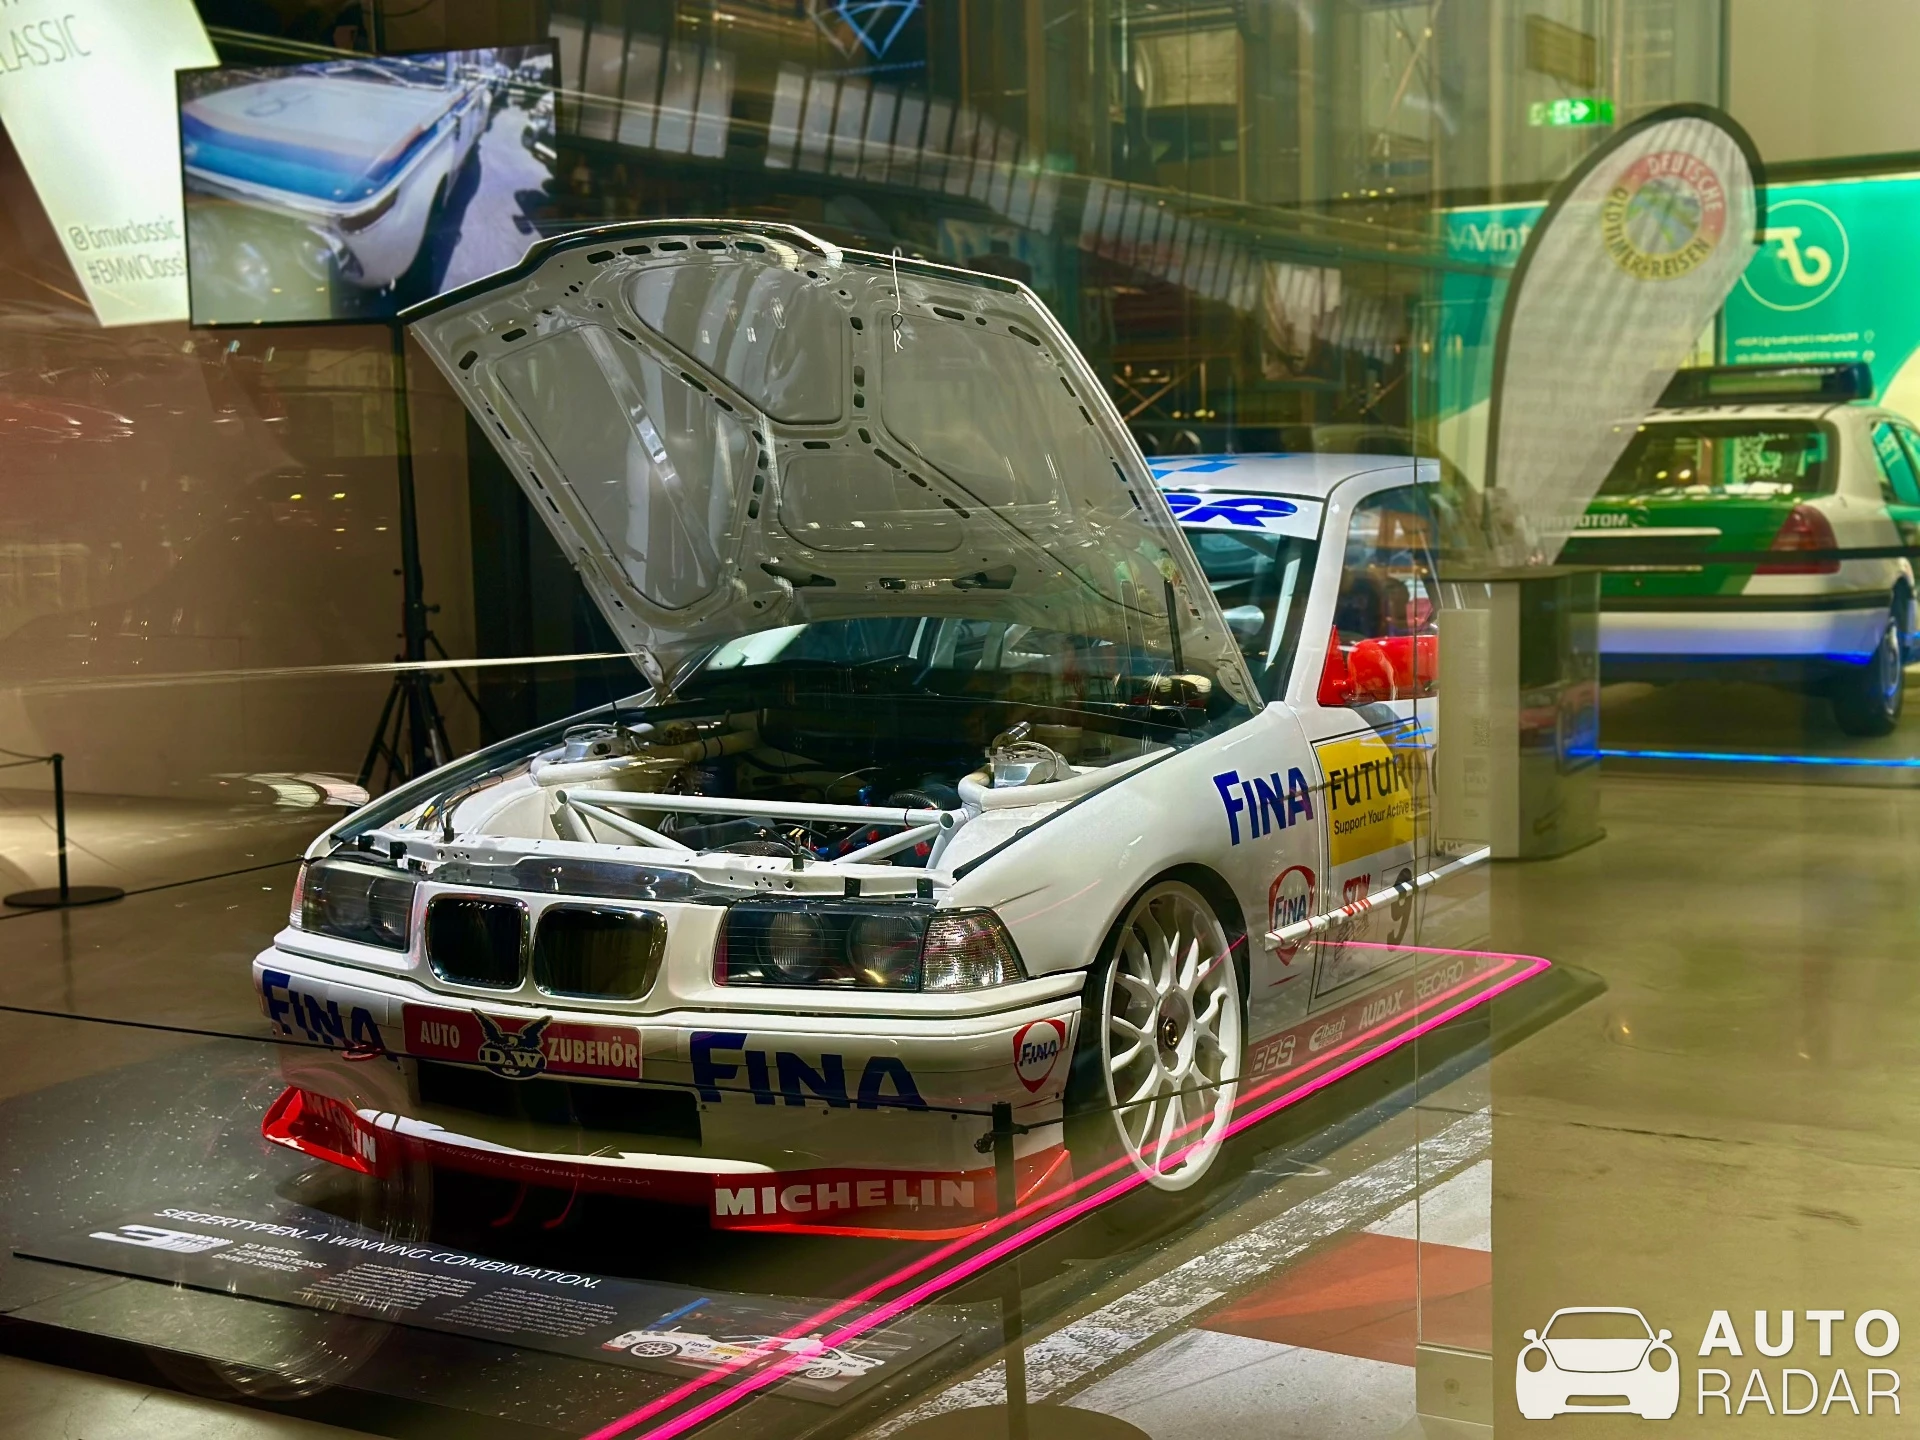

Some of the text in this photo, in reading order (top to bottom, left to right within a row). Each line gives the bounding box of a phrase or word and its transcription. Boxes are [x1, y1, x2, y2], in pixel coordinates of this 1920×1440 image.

[0, 14, 91, 74] LASSIC
[1648, 153, 1722, 212] DEUTSCHE
[1213, 766, 1314, 846] FINA
[1334, 811, 1367, 836] Support
[1368, 807, 1386, 829] Your
[1387, 801, 1410, 822] Active
[1274, 893, 1307, 932] FINA
[1416, 961, 1464, 999] RECARO
[262, 969, 398, 1063] FINA
[1359, 989, 1404, 1030] AUDAX
[420, 1021, 460, 1049] AUTO
[547, 1036, 638, 1069] ZUBEHÖR
[1019, 1039, 1058, 1067] FINA
[1252, 1035, 1296, 1073] BBS
[690, 1031, 930, 1112] FINA
[715, 1179, 975, 1216] MICHELIN
[154, 1208, 303, 1239] SIEGERTYPEN.
[304, 1231, 326, 1243] A
[327, 1233, 433, 1260] WINNING
[430, 1252, 602, 1289] COMBINATION.
[238, 1249, 327, 1269] GENERATIONS
[260, 1244, 302, 1257] YEARS
